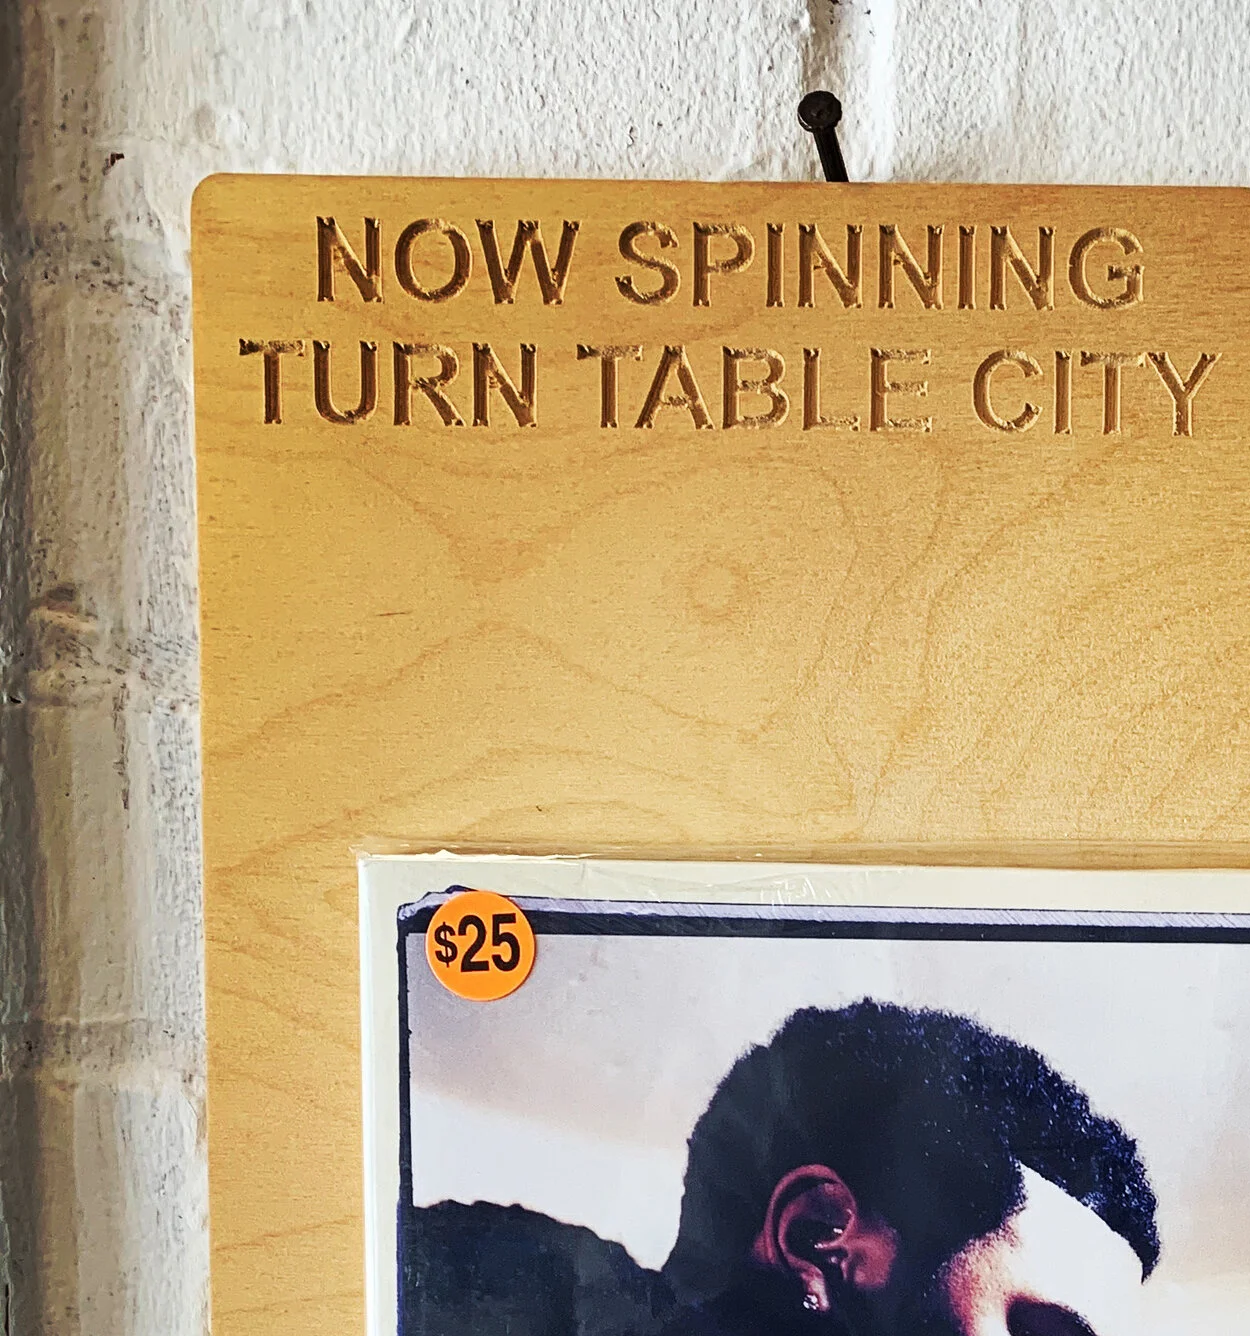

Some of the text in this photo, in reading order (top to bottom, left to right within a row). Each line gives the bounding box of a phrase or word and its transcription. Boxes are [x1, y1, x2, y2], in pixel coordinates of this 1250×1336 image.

[315, 216, 1147, 310] NOW SPINNING
[238, 338, 1222, 438] TURN TABLE CITY
[434, 912, 521, 973] $25
